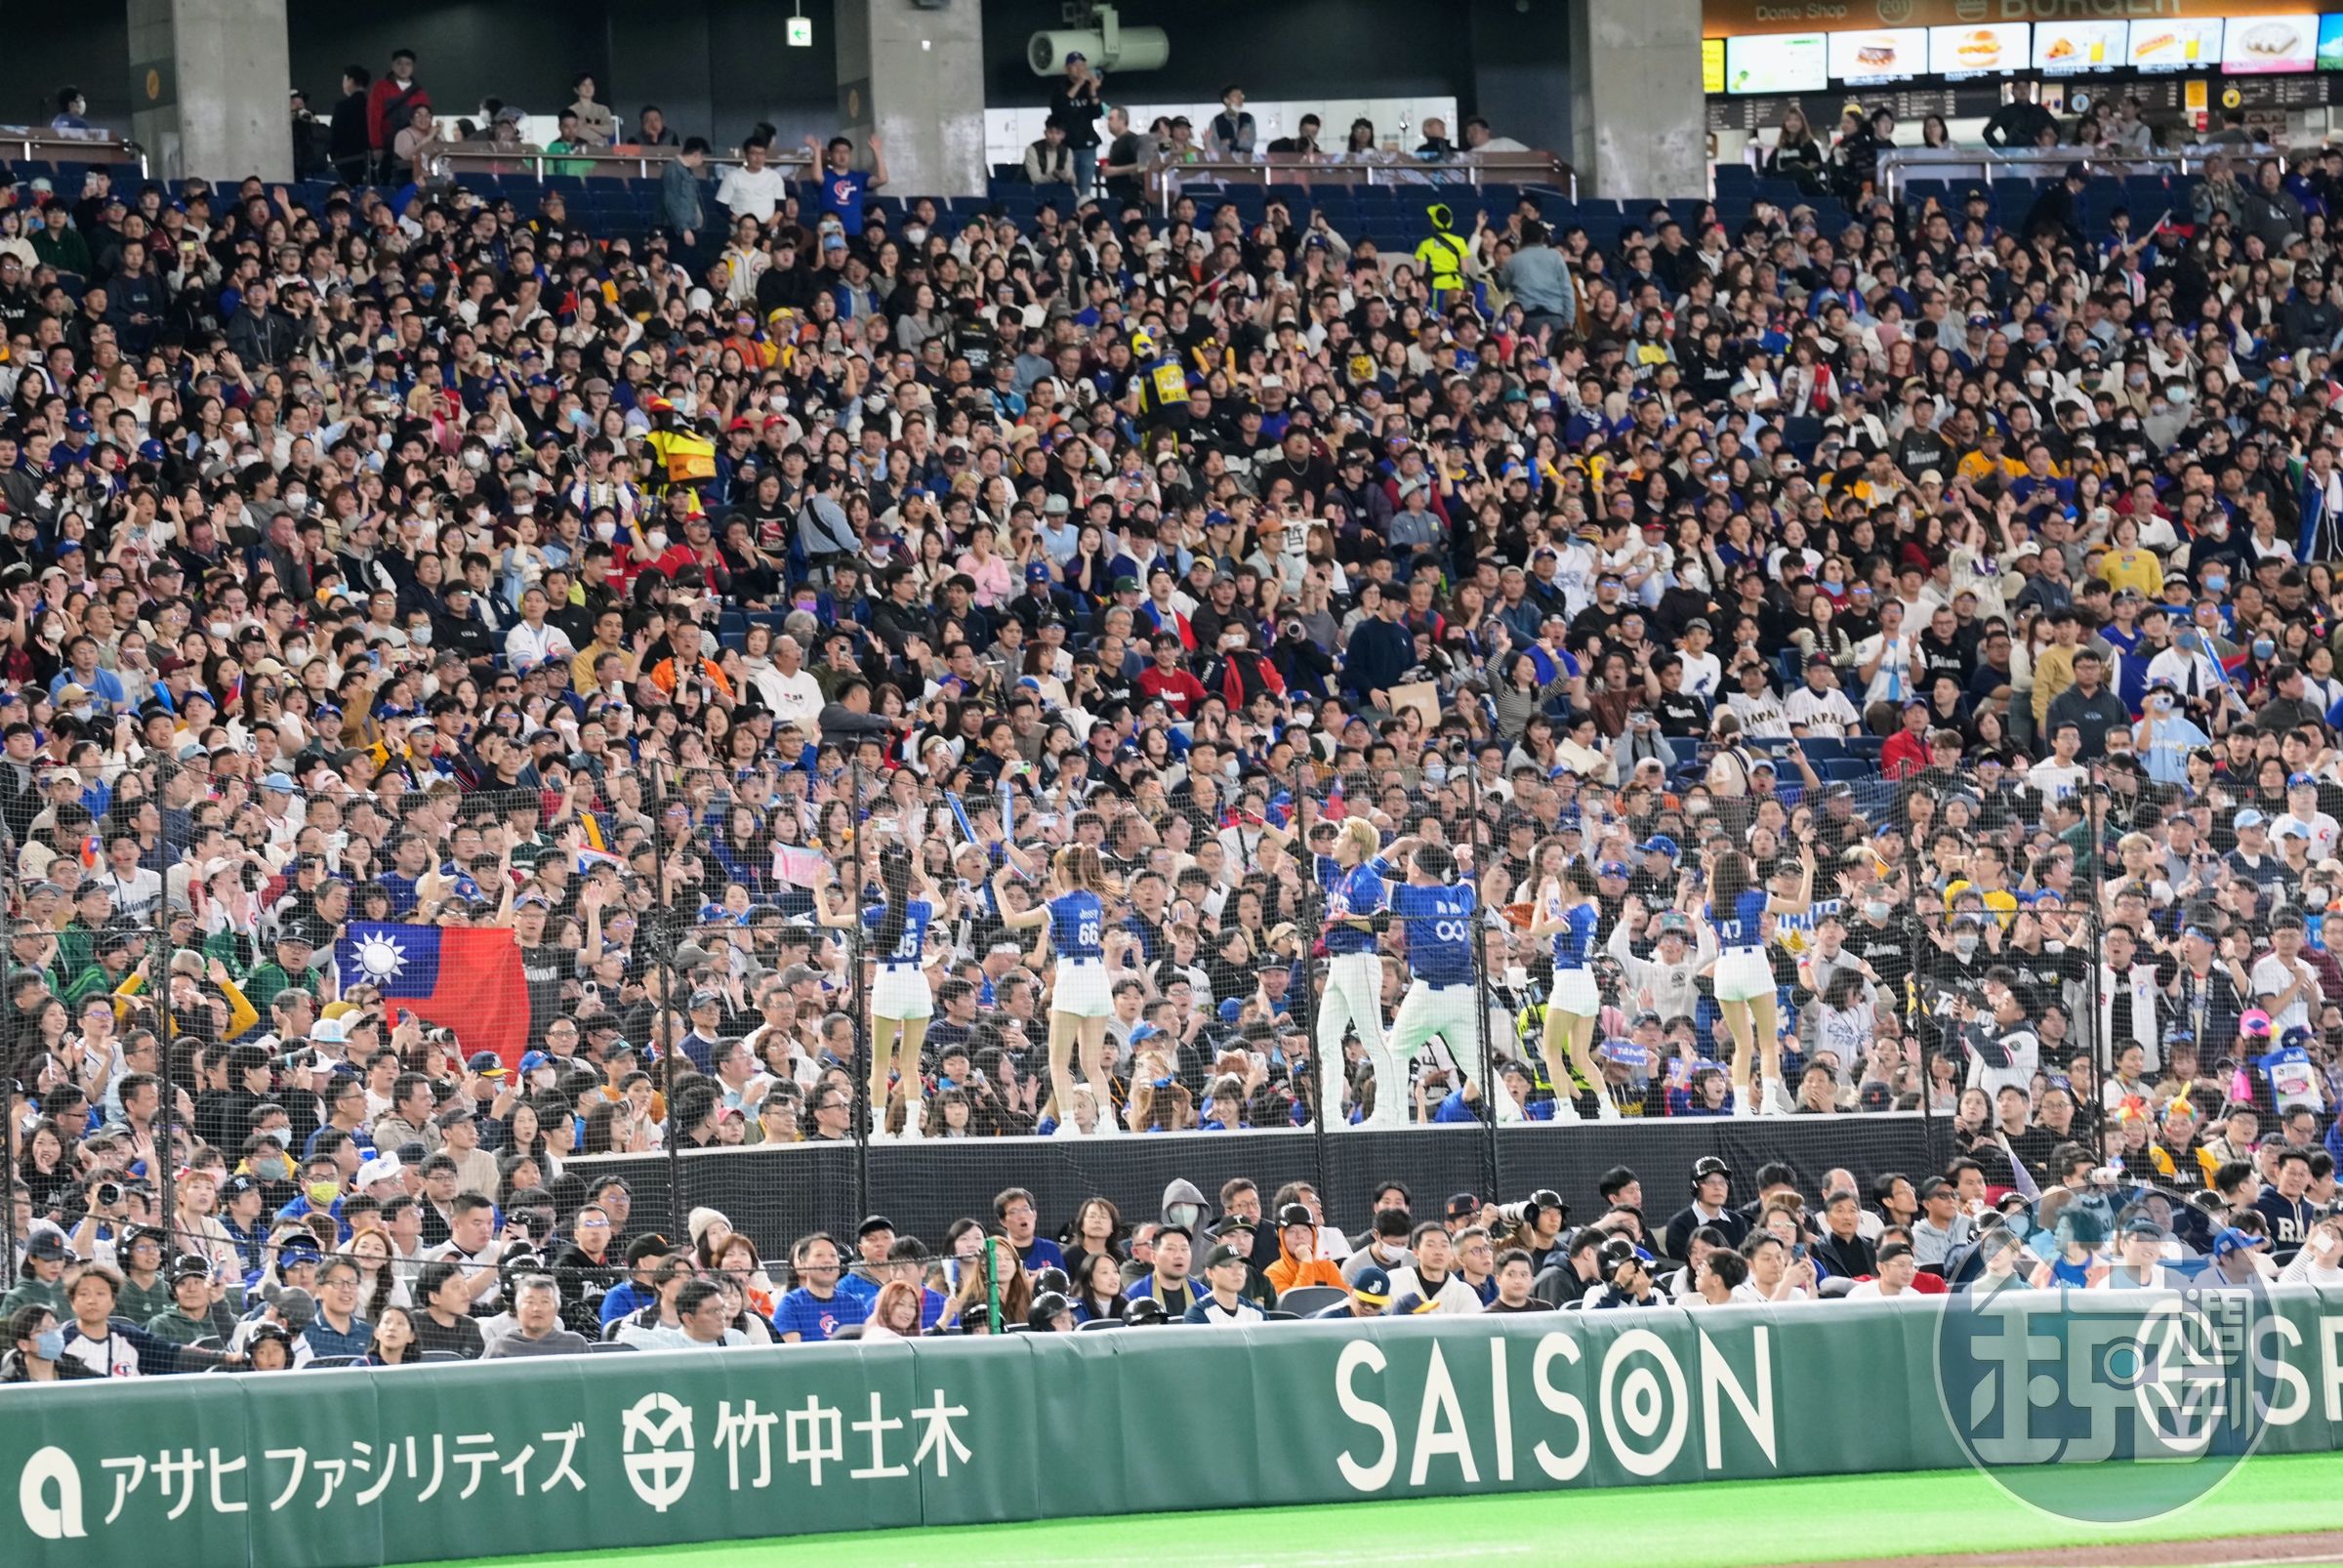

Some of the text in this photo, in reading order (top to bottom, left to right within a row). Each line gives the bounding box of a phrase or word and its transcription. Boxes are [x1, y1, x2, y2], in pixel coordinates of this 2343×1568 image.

[1756, 4, 1847, 21] Dome Shop
[1078, 921, 1099, 946] 66
[713, 1389, 972, 1491] 竹中土木
[1335, 1325, 1778, 1492] SAISON
